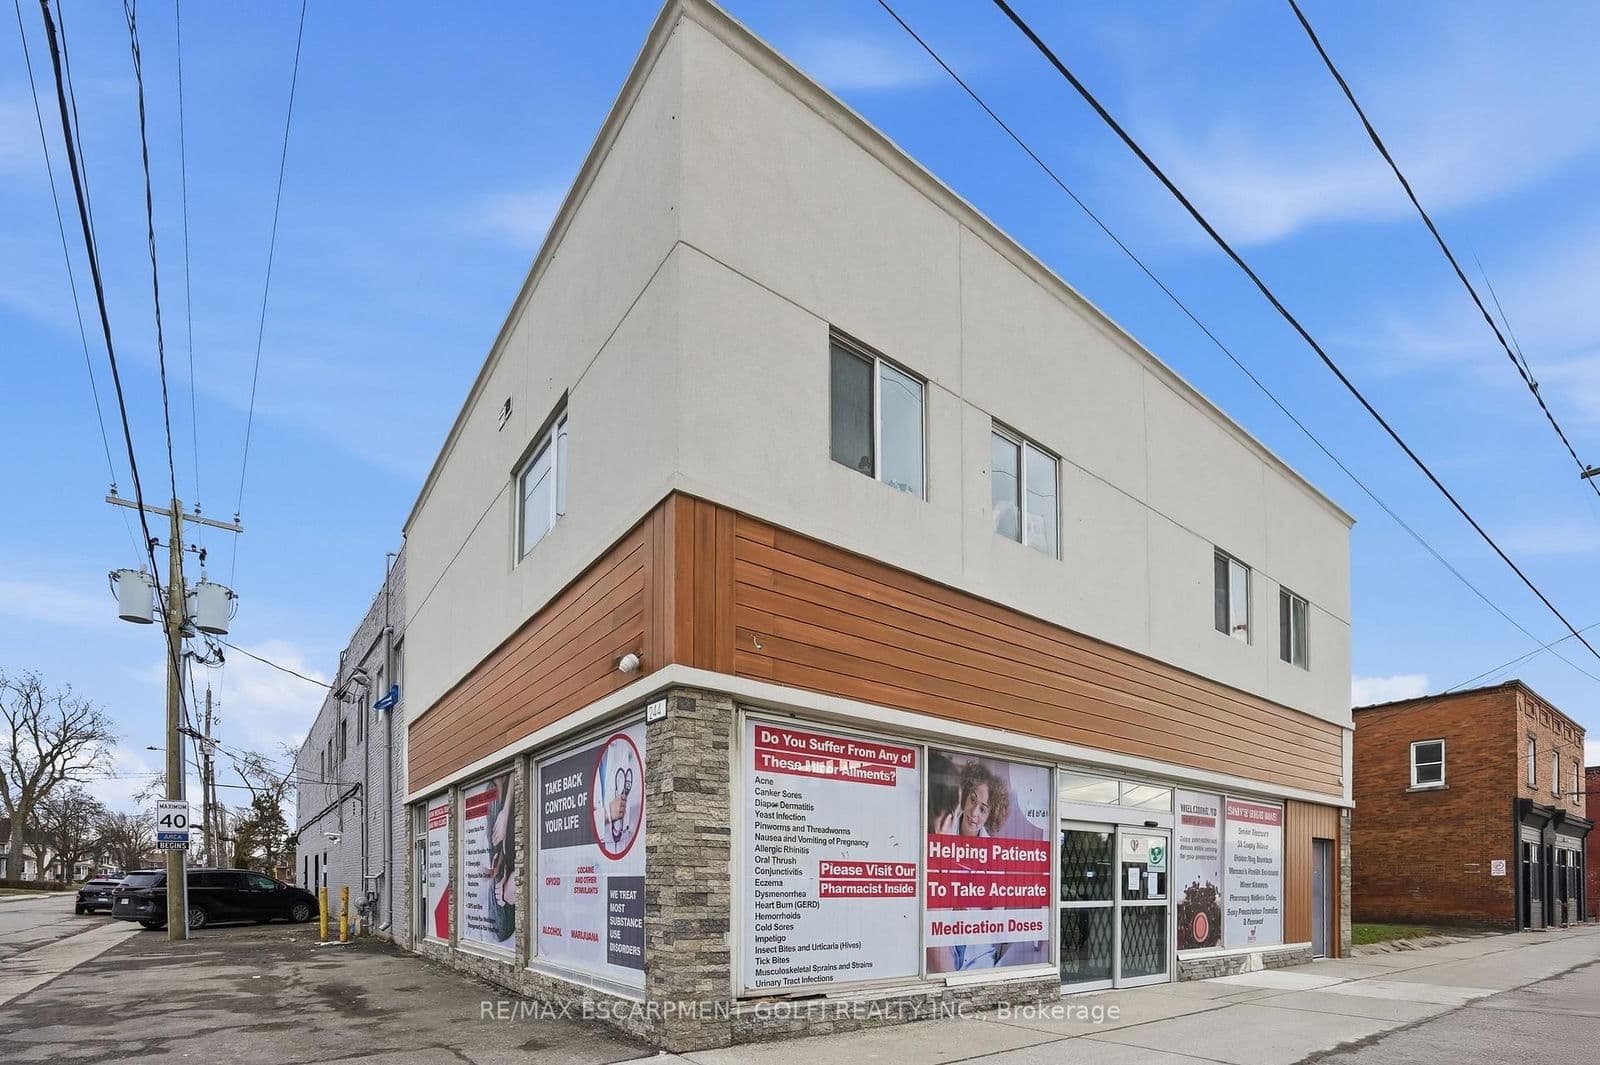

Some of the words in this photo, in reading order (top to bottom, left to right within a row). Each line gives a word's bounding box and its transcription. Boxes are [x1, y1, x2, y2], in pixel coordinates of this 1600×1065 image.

[761, 731, 779, 744] Do
[783, 733, 806, 749] You
[809, 739, 845, 754] Suffer
[848, 744, 876, 758] From
[878, 749, 899, 764] Any
[901, 753, 912, 764] of
[762, 754, 801, 770] These
[545, 779, 562, 795] TAKE
[563, 772, 583, 790] BACK
[755, 776, 774, 786] Acne
[755, 788, 781, 798] Canker
[782, 790, 802, 799] Sores
[545, 795, 576, 815] CONTROL
[577, 792, 588, 807] OF
[780, 801, 814, 811] Dermatitis
[160, 814, 186, 828] 40
[755, 810, 775, 819] Yeast
[776, 812, 806, 821] Infection
[545, 818, 563, 833] YOUR
[564, 815, 579, 830] LIFE
[755, 822, 790, 832] Pinworms
[792, 824, 805, 832] and
[806, 825, 851, 835] Threadworms
[755, 833, 782, 842] Nausea
[798, 836, 827, 846] Vomiting
[836, 838, 869, 848] Pregnancy
[755, 844, 782, 855] Allergic
[784, 846, 810, 854] Rhinitis
[929, 841, 987, 863] Helping
[992, 845, 1047, 862] Patients
[755, 856, 770, 864] Oral
[771, 856, 796, 865] Thrush
[755, 867, 803, 876] Conjunctivitis
[821, 863, 863, 876] Please
[866, 864, 893, 877] Visit
[895, 864, 916, 876] Our
[755, 879, 783, 887] Eczema
[821, 883, 882, 894] Pharmacist
[885, 884, 914, 894] Inside
[609, 890, 618, 899] WE
[620, 890, 637, 900] TREAT
[755, 890, 807, 900] Dysmenorrhea
[928, 882, 947, 897] To
[951, 882, 986, 897] Take
[989, 883, 1047, 897] Accurate
[609, 903, 625, 913] MOST
[755, 901, 775, 909] Heart
[776, 901, 793, 909] Burn
[794, 900, 820, 910] (GERD)
[755, 912, 801, 920] Hemorrhoids
[609, 916, 642, 928] SUBSTANCE
[774, 923, 794, 931] Sores
[932, 920, 1004, 936] Medication
[1008, 919, 1043, 933] Doses
[542, 926, 562, 936] ALCOHOL
[609, 930, 621, 939] USE
[755, 935, 786, 944] Impetigo
[609, 942, 641, 956] DISORDERS
[755, 945, 777, 954] Insect
[778, 944, 796, 953] Bites
[797, 944, 810, 952] and
[811, 942, 839, 951] Urticaria
[840, 941, 861, 951] (Hives)
[755, 957, 771, 965] Tick
[772, 956, 790, 964] Bites
[755, 965, 811, 977] Musculoskeletal
[812, 963, 837, 973] Sprains
[838, 963, 850, 971] and
[851, 961, 873, 969] Strains
[755, 978, 781, 988] Urinary
[783, 977, 800, 986] Tract
[802, 975, 833, 984] Infections
